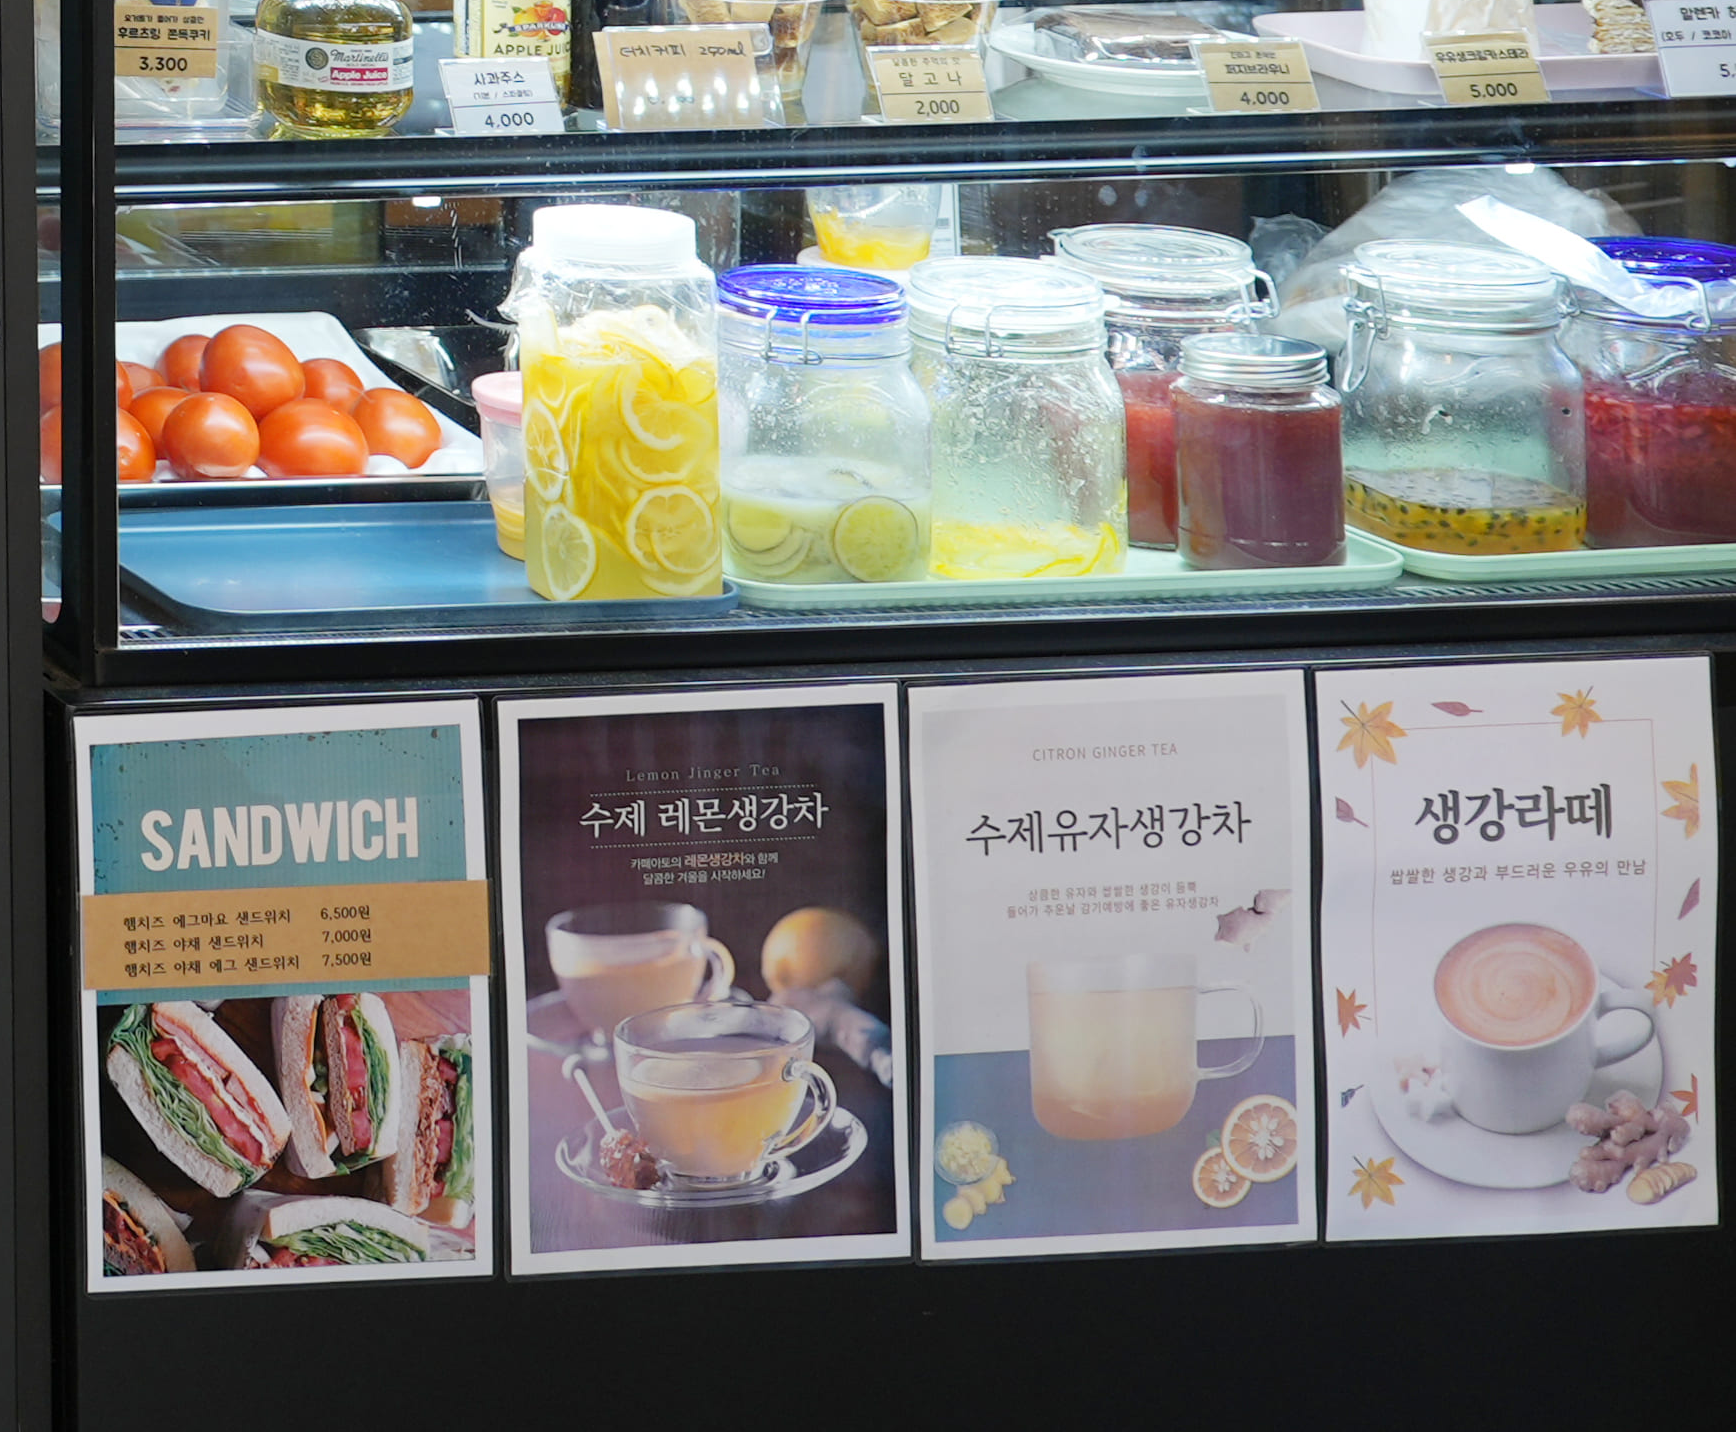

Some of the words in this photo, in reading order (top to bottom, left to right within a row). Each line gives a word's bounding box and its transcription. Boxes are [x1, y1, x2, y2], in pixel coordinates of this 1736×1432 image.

[494, 44, 542, 55] APPLE
[139, 57, 187, 71] 3,300
[332, 70, 361, 80] Apple
[363, 69, 387, 79] Juice
[474, 72, 525, 86] 사과주스
[1240, 90, 1289, 107] 4,000
[1470, 82, 1517, 98] 5,000
[915, 99, 960, 116] 2,000
[485, 112, 534, 128] 4,000
[1032, 747, 1086, 762] CITRON
[1092, 744, 1146, 760] GINGER
[1152, 743, 1178, 757] TEA
[626, 768, 679, 783] Lemon
[749, 764, 780, 777] Tea
[579, 800, 646, 839] 수제
[658, 792, 828, 836] 레몬생강차
[1415, 783, 1613, 845] 생강라떼
[140, 797, 418, 872] SANDWICH
[966, 801, 1252, 856] 수제유자생강차
[123, 916, 165, 931] 햄치즈
[173, 912, 228, 928] 에그마요
[236, 909, 291, 925] 샌드위치
[321, 906, 370, 920] 6,500원
[322, 929, 371, 943] 7,000원
[322, 952, 371, 967] 7,500원
